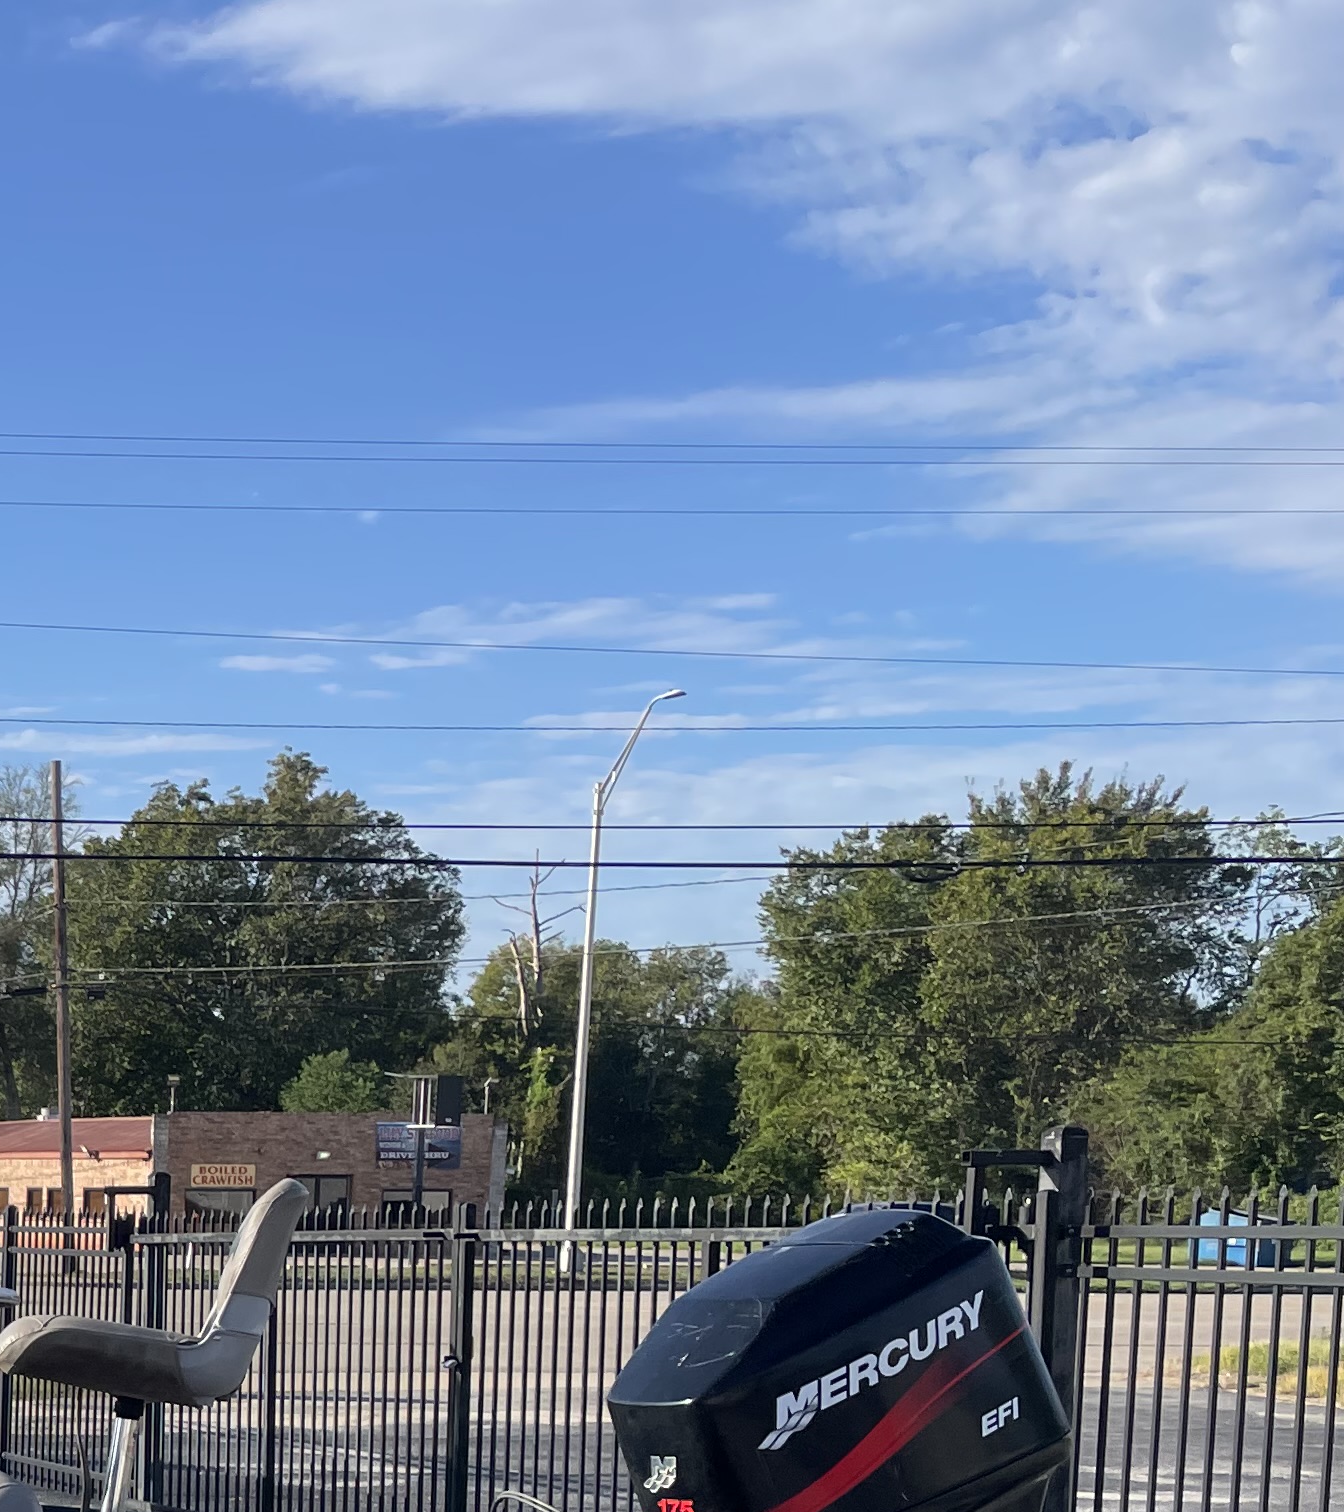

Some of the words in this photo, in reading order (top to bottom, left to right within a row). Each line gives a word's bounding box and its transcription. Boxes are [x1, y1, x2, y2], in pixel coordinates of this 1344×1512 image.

[380, 1151, 416, 1159] DRIVE
[199, 1166, 248, 1175] BOILED
[192, 1175, 253, 1186] CRAWFISH
[758, 1290, 984, 1450] MERCURY
[981, 1396, 1020, 1438] EFI
